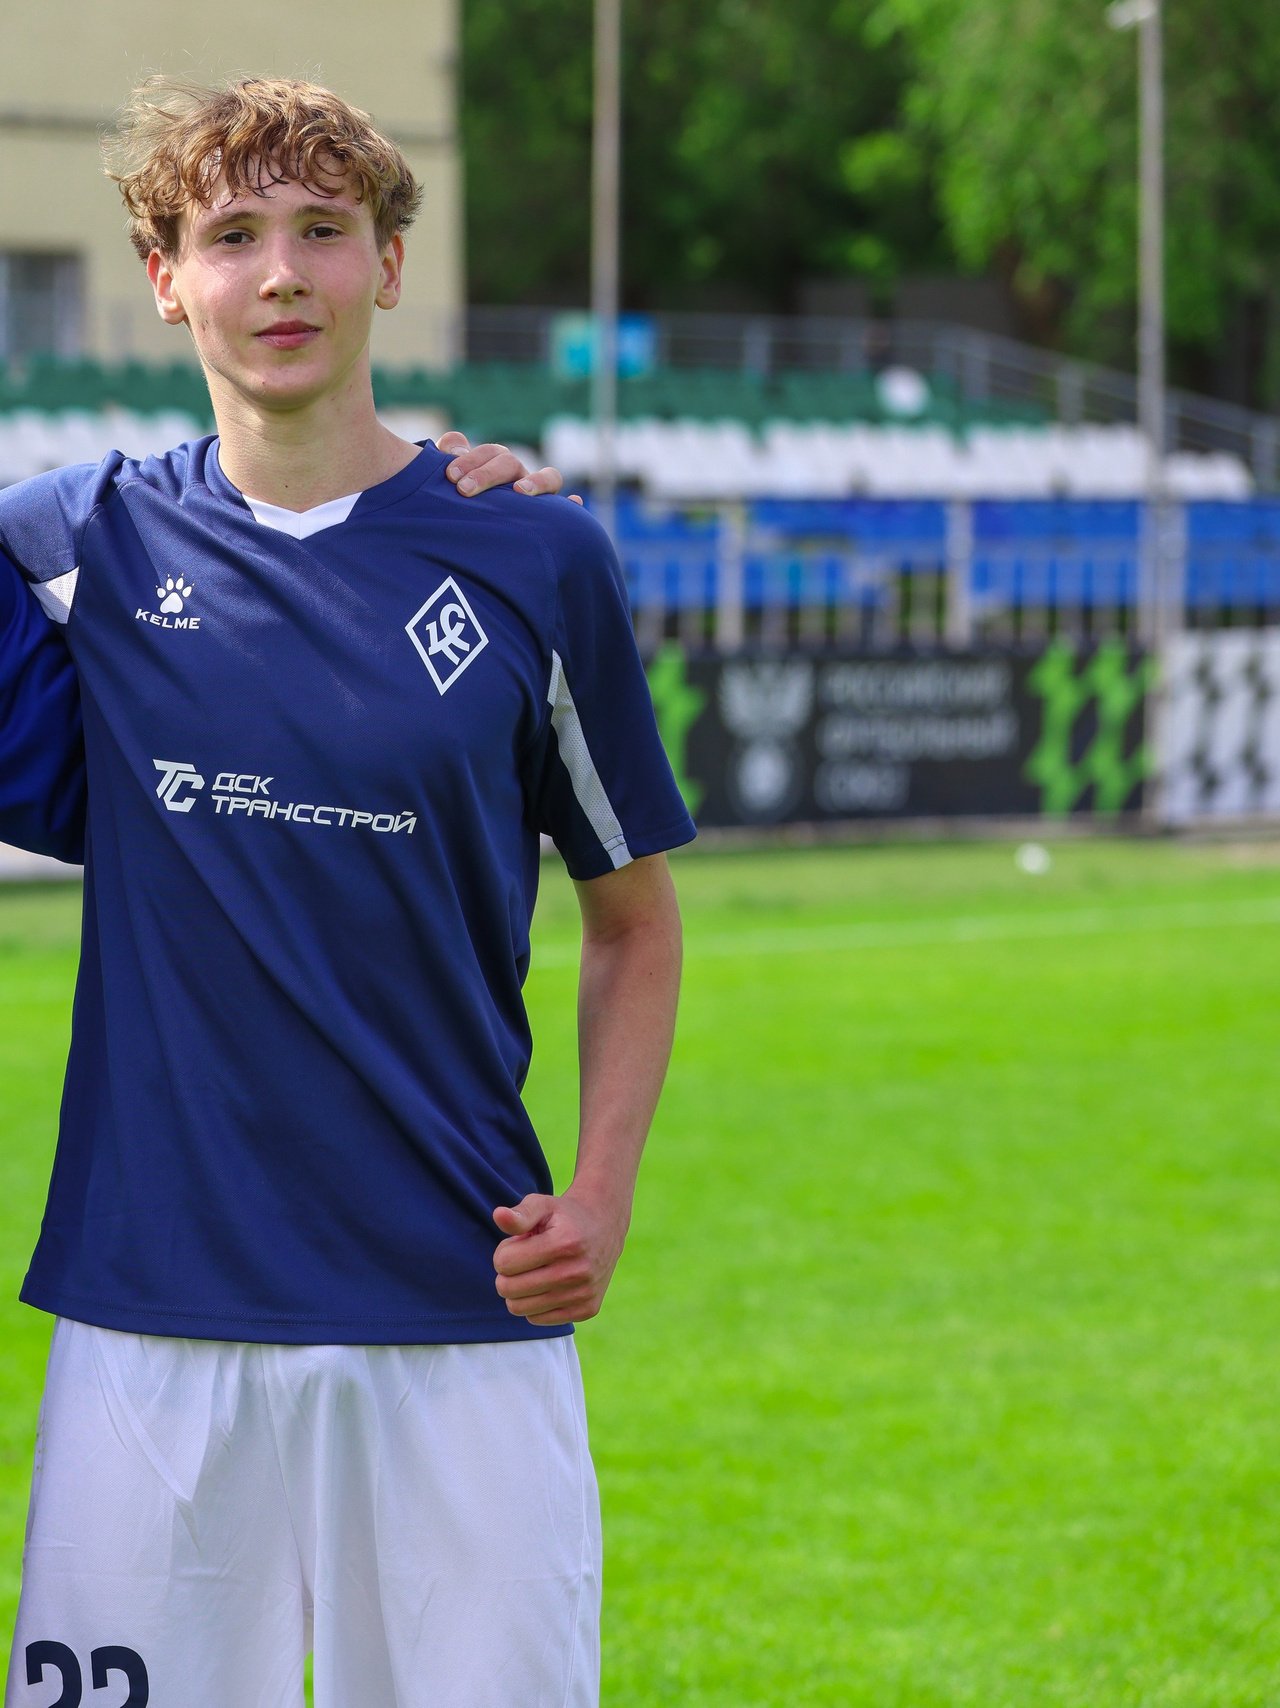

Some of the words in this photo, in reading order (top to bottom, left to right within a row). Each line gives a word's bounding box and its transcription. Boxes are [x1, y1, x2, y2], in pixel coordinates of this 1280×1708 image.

[135, 606, 201, 630] KELME
[211, 772, 274, 796] ДСК
[211, 794, 417, 834] ТРАНССТРОЙ
